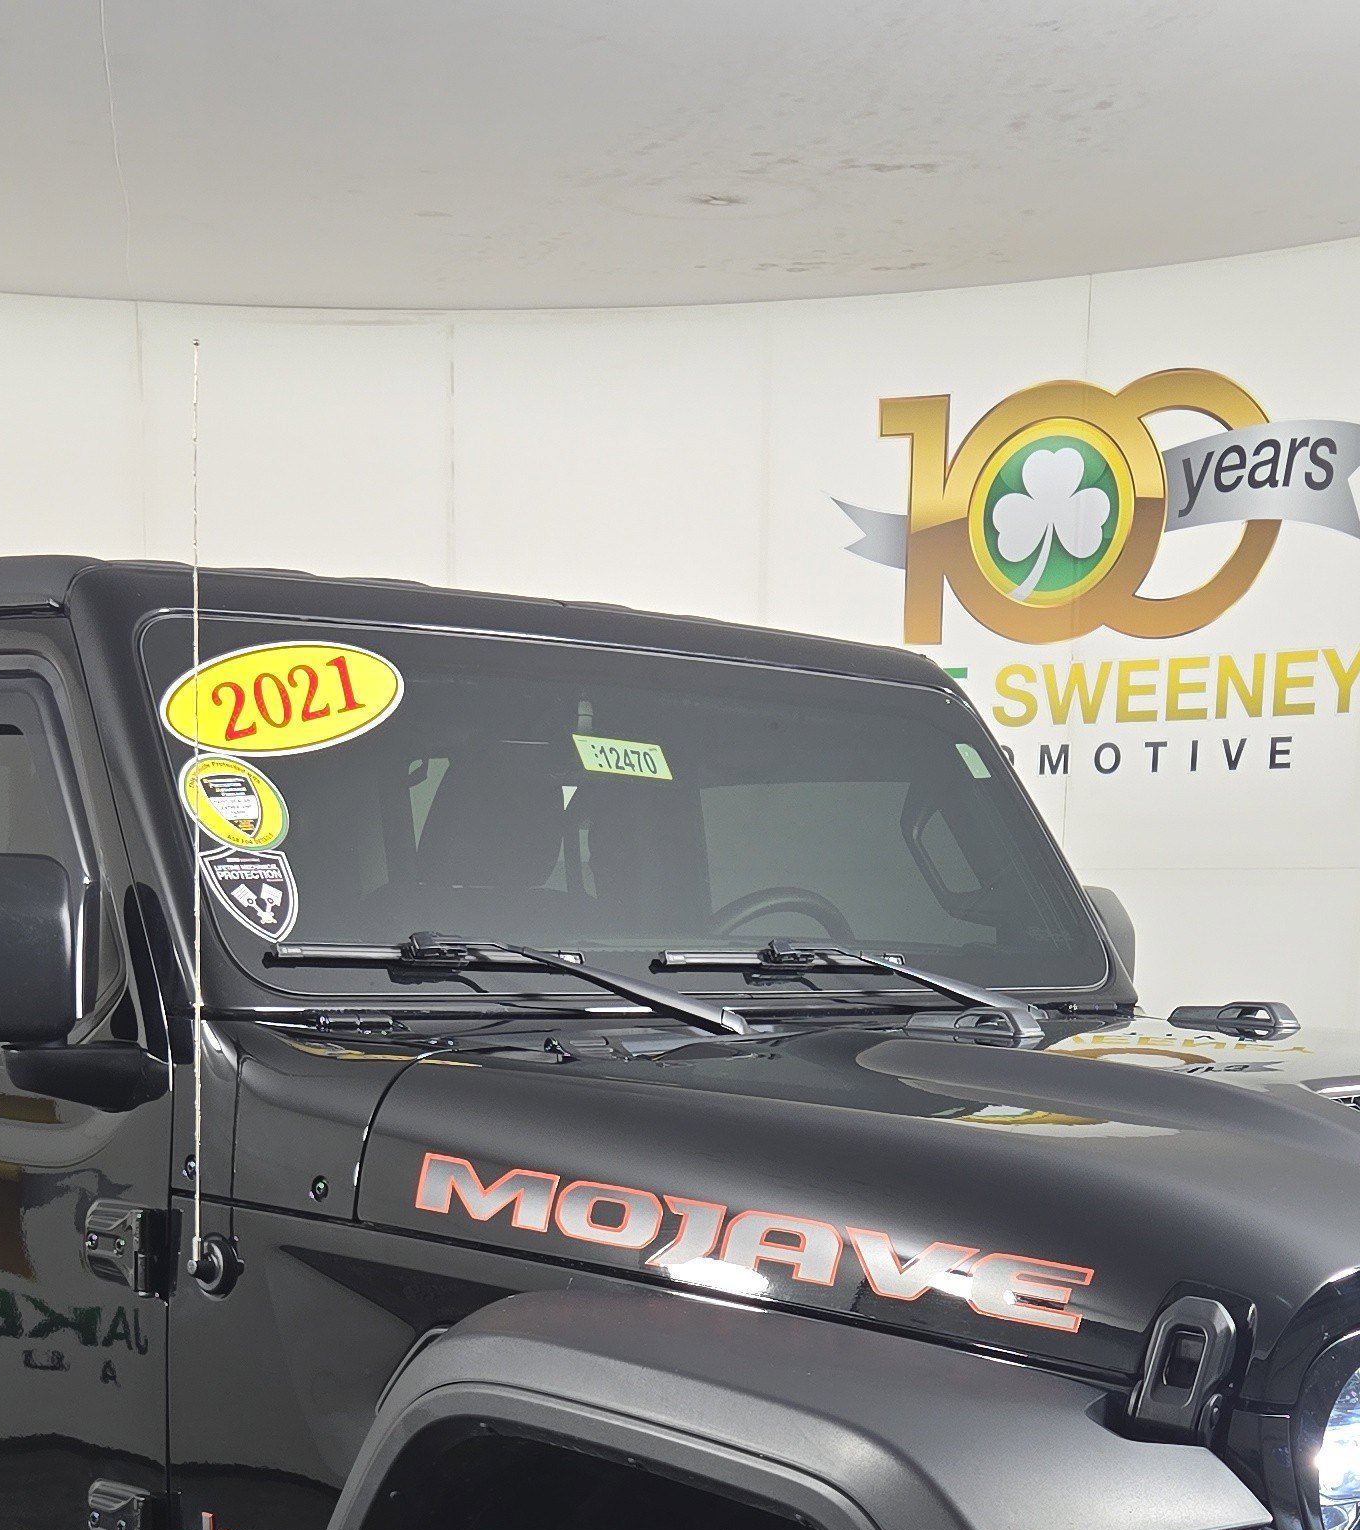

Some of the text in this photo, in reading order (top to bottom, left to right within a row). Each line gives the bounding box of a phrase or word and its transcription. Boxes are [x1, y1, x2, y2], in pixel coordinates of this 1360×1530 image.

[878, 367, 1285, 646] 100
[1177, 434, 1338, 518] years
[210, 655, 366, 742] 2021
[598, 745, 658, 775] 12470
[217, 869, 283, 881] PROTECTION
[414, 1151, 1095, 1333] MOJAVE
